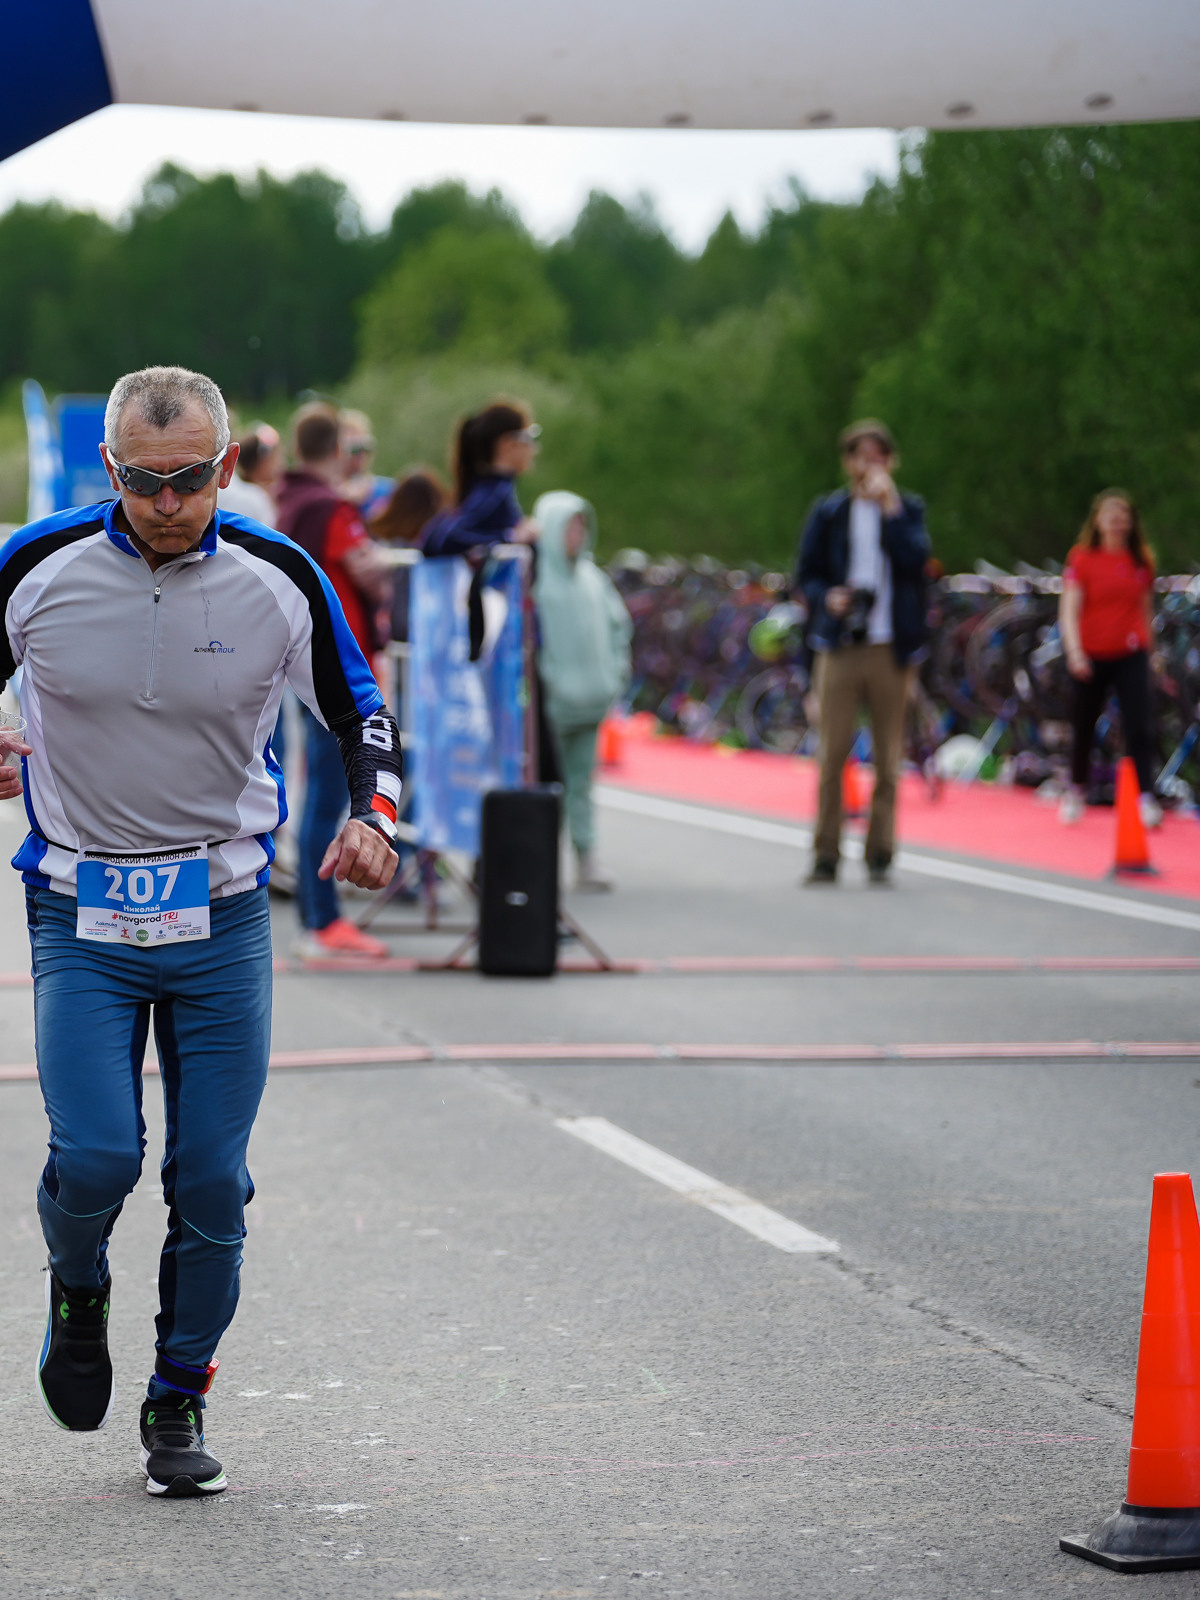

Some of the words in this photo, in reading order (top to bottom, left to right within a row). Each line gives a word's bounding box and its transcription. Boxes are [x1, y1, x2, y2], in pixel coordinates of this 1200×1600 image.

[142, 853, 180, 864] ТРИАТЛОН
[181, 850, 198, 859] 2023
[104, 864, 181, 904] 207
[123, 904, 160, 913] Николай
